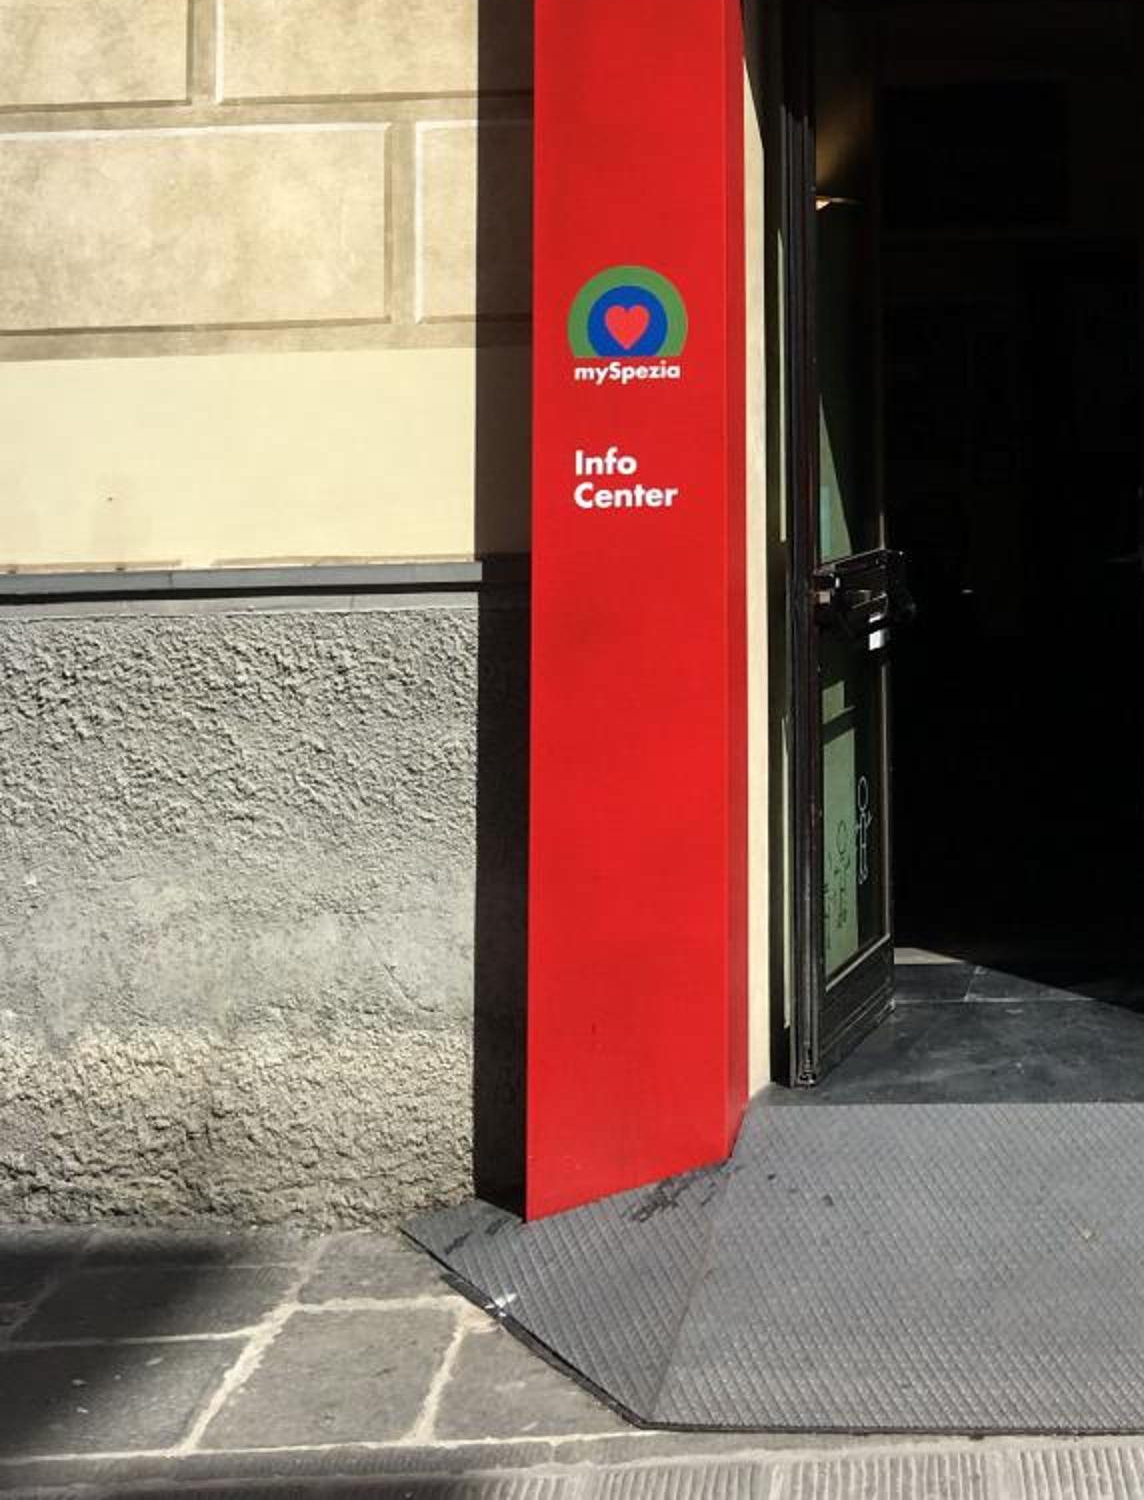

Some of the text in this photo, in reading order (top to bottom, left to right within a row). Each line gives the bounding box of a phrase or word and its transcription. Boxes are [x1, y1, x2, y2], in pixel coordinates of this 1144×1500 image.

[575, 360, 680, 384] mySpezia
[576, 447, 637, 475] Info
[574, 482, 678, 508] Center
